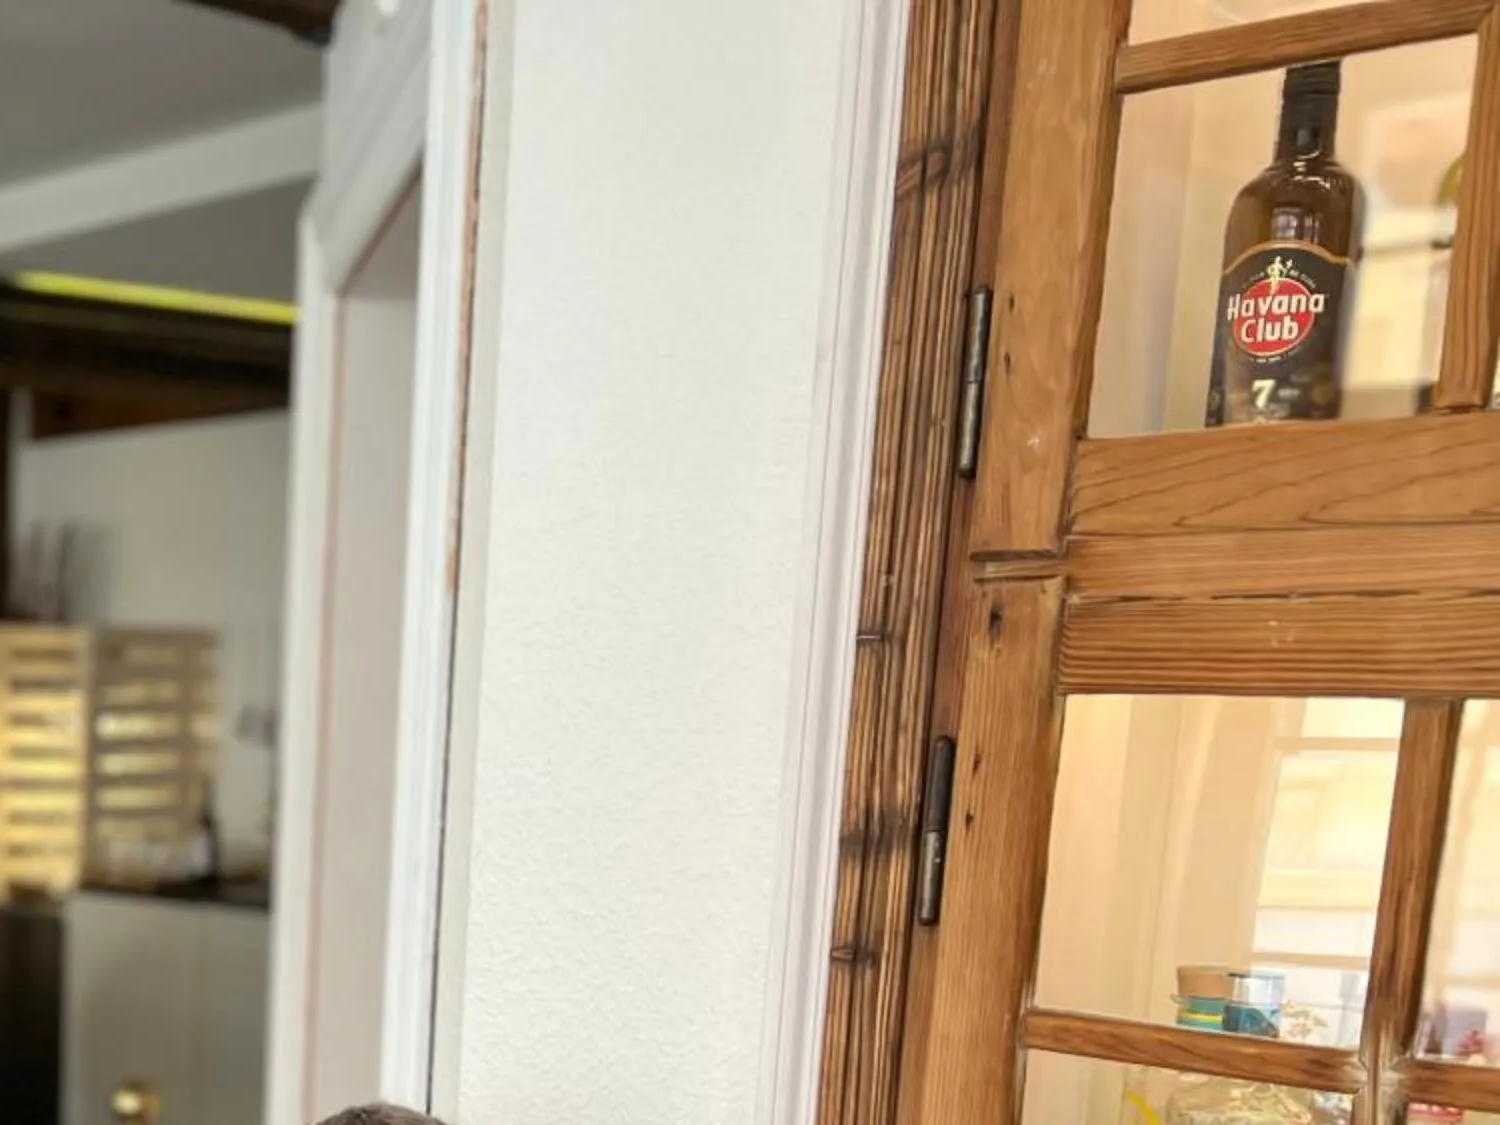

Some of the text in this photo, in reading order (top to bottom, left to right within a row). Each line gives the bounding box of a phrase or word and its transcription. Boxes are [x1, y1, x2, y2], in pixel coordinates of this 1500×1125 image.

[1227, 293, 1325, 320] Havana
[1241, 315, 1299, 343] Club
[1252, 379, 1276, 409] 7
